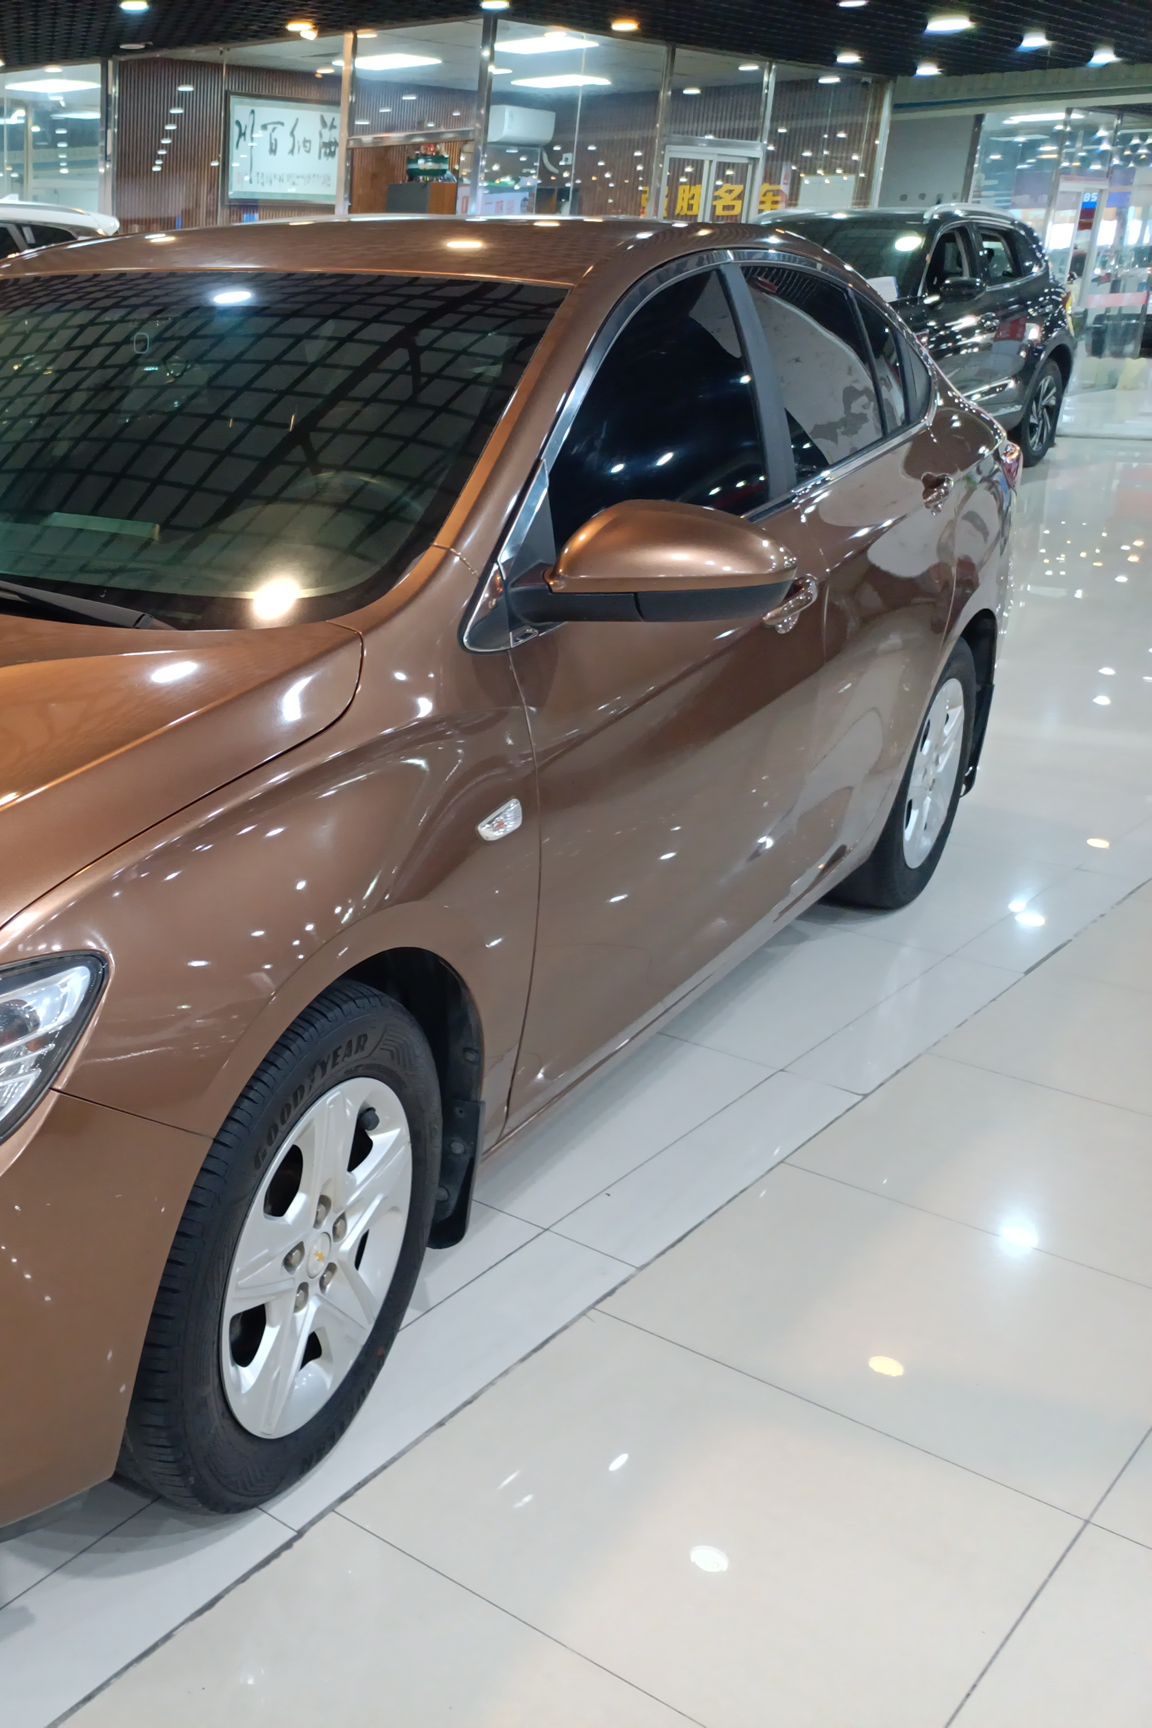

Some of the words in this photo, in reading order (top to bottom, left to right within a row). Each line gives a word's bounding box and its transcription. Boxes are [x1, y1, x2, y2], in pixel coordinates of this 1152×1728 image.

[640, 183, 784, 218] 胜名车
[254, 1033, 368, 1170] GOODYEAR
